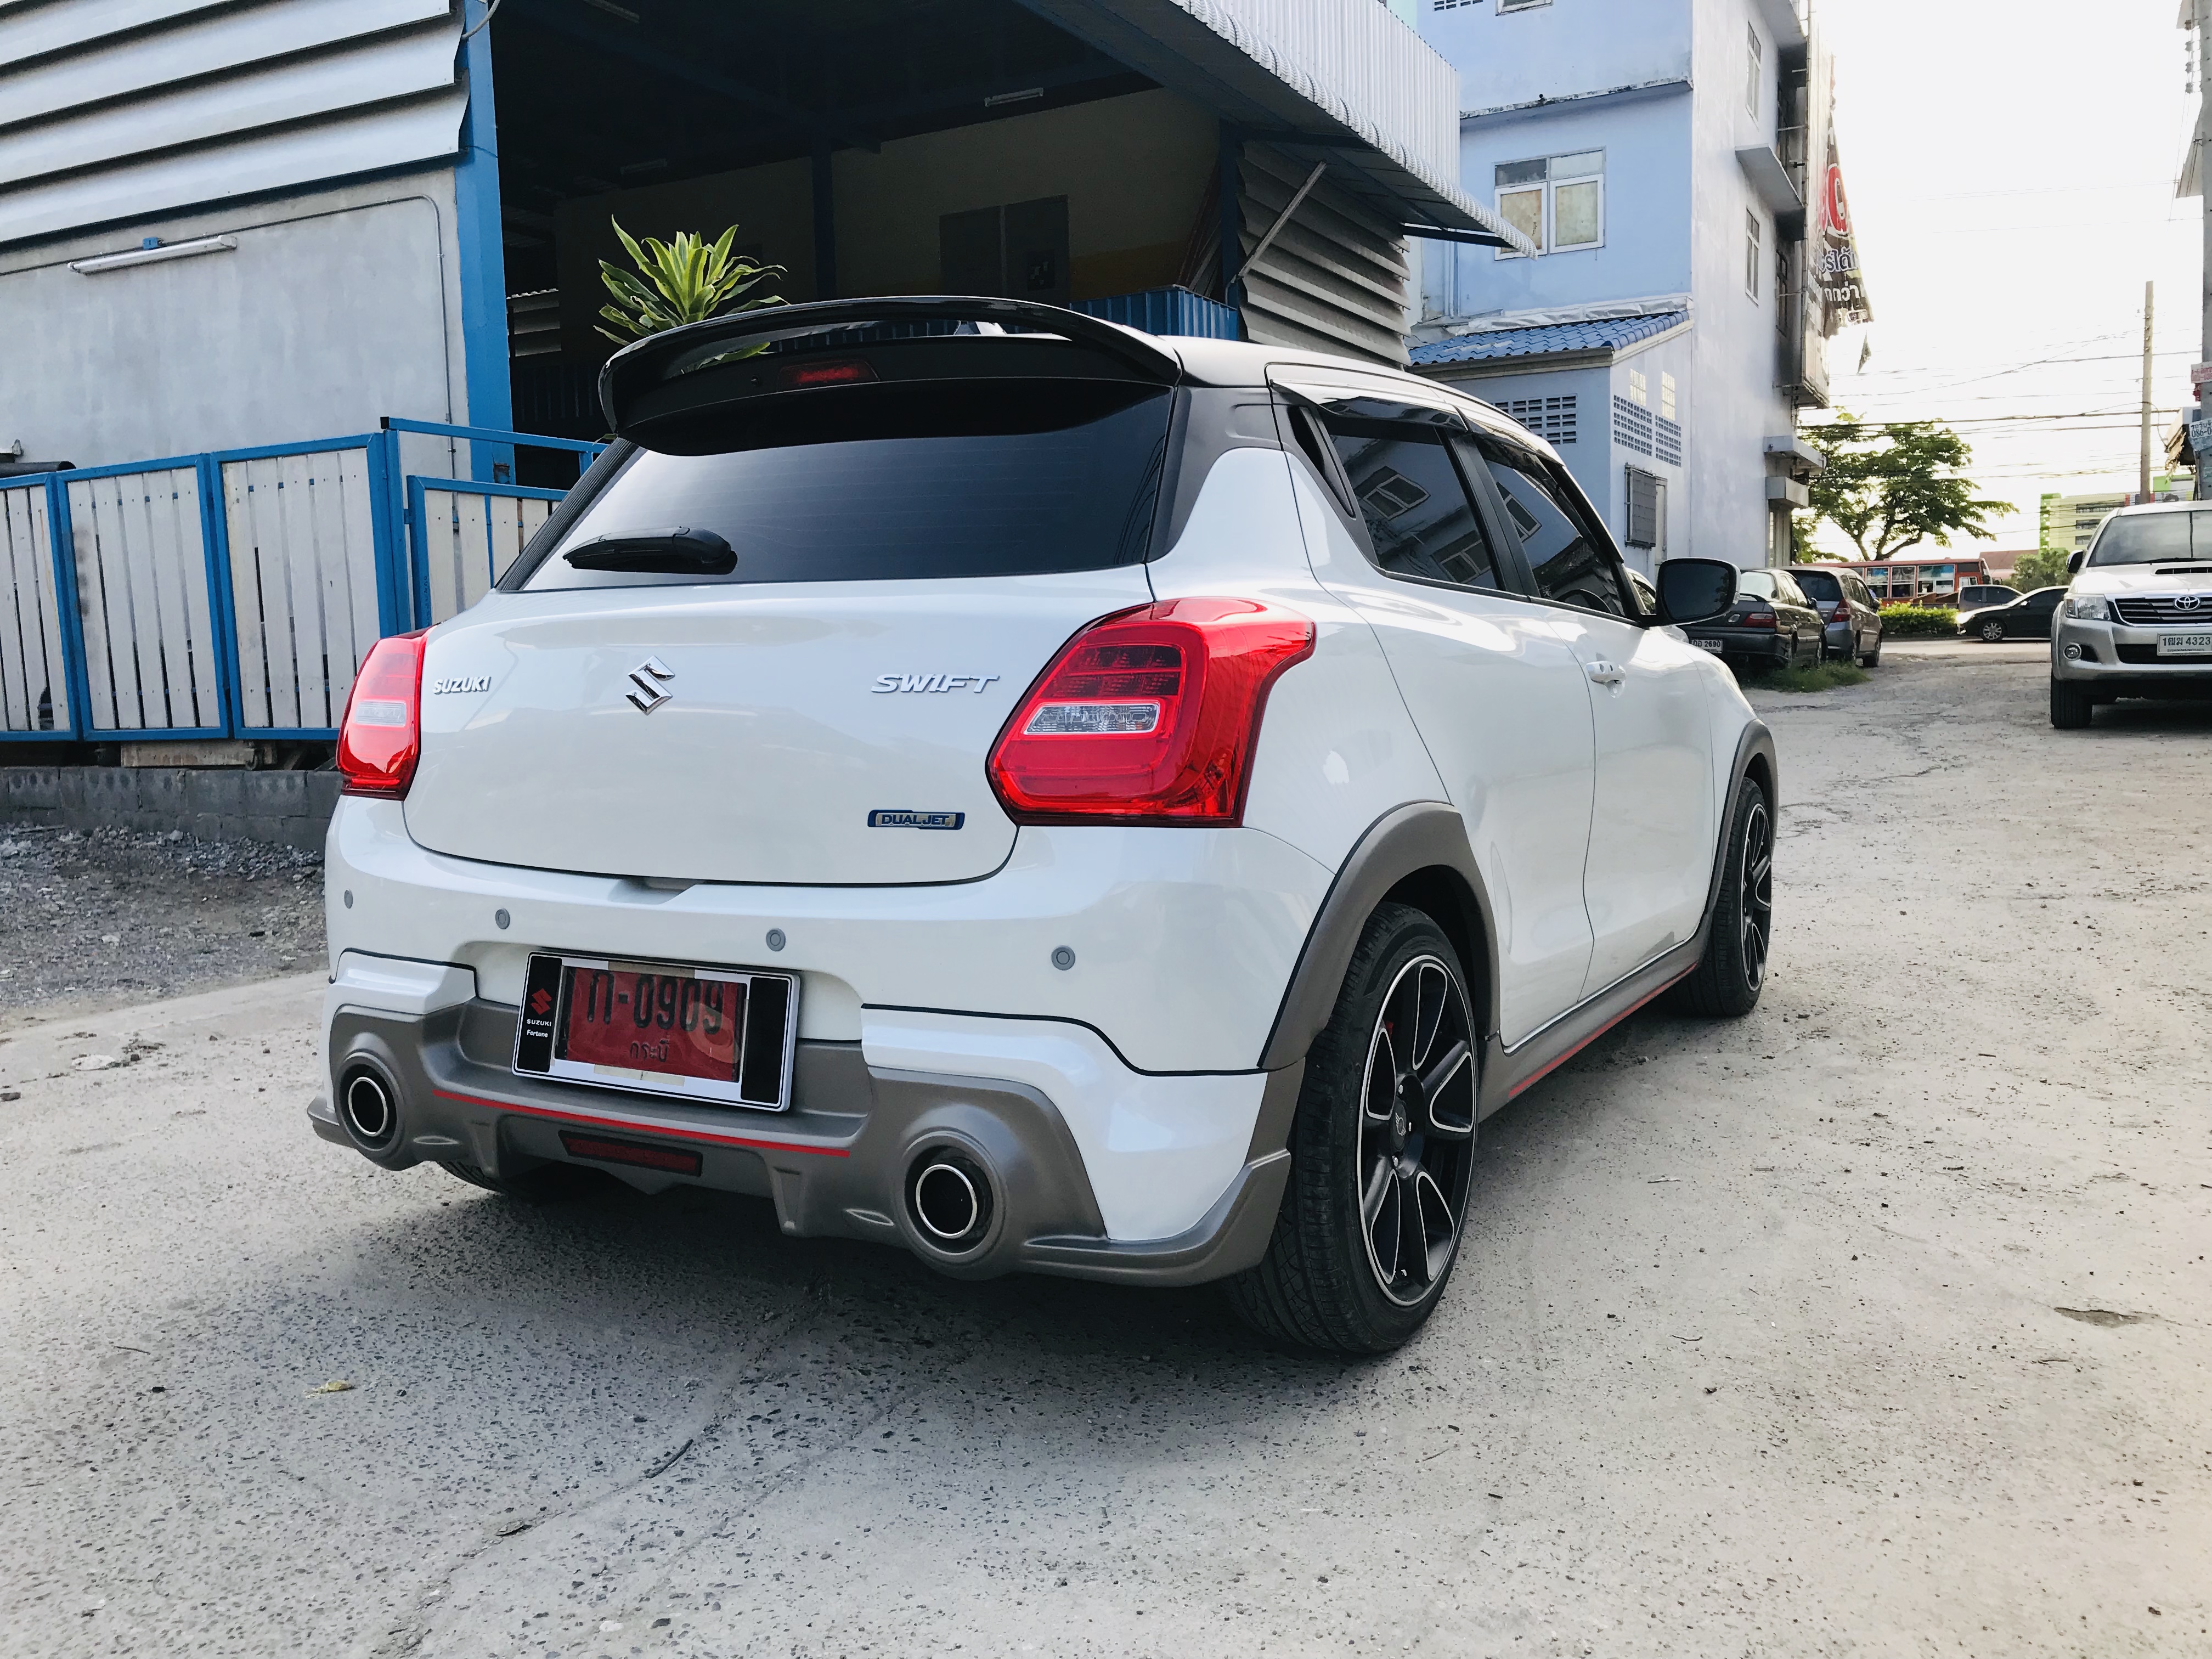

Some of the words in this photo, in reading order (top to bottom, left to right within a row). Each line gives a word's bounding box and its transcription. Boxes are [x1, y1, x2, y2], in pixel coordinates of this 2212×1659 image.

[2186, 636, 2211, 646] 4323
[432, 676, 492, 695] SUZUKI
[871, 673, 1000, 693] SWIFT
[526, 1019, 552, 1027] SUZUKI
[526, 1029, 549, 1038] Fortune
